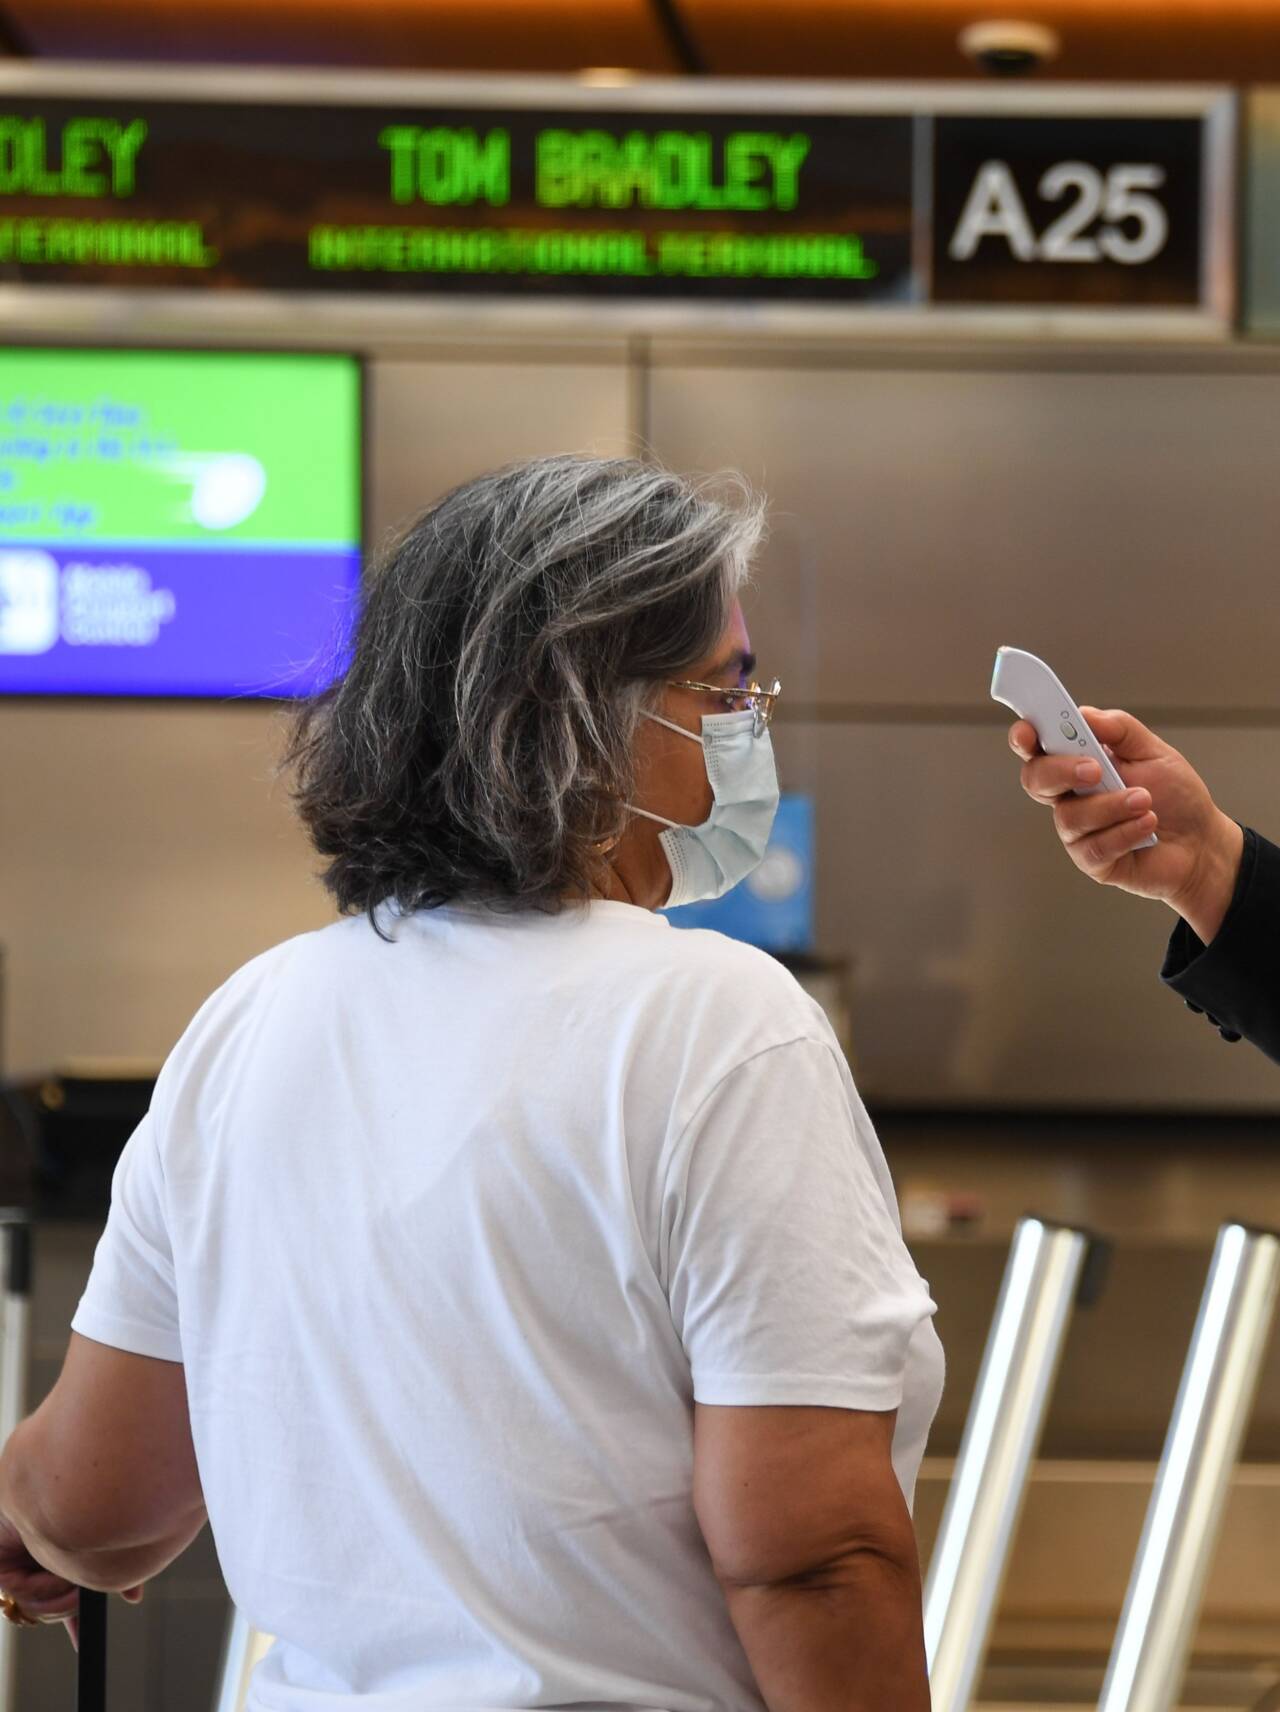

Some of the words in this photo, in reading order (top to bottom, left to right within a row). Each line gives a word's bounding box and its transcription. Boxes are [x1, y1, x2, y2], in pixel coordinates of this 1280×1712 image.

[379, 125, 511, 206] TOM
[535, 129, 811, 211] BRADLEY
[949, 160, 1168, 264] A25
